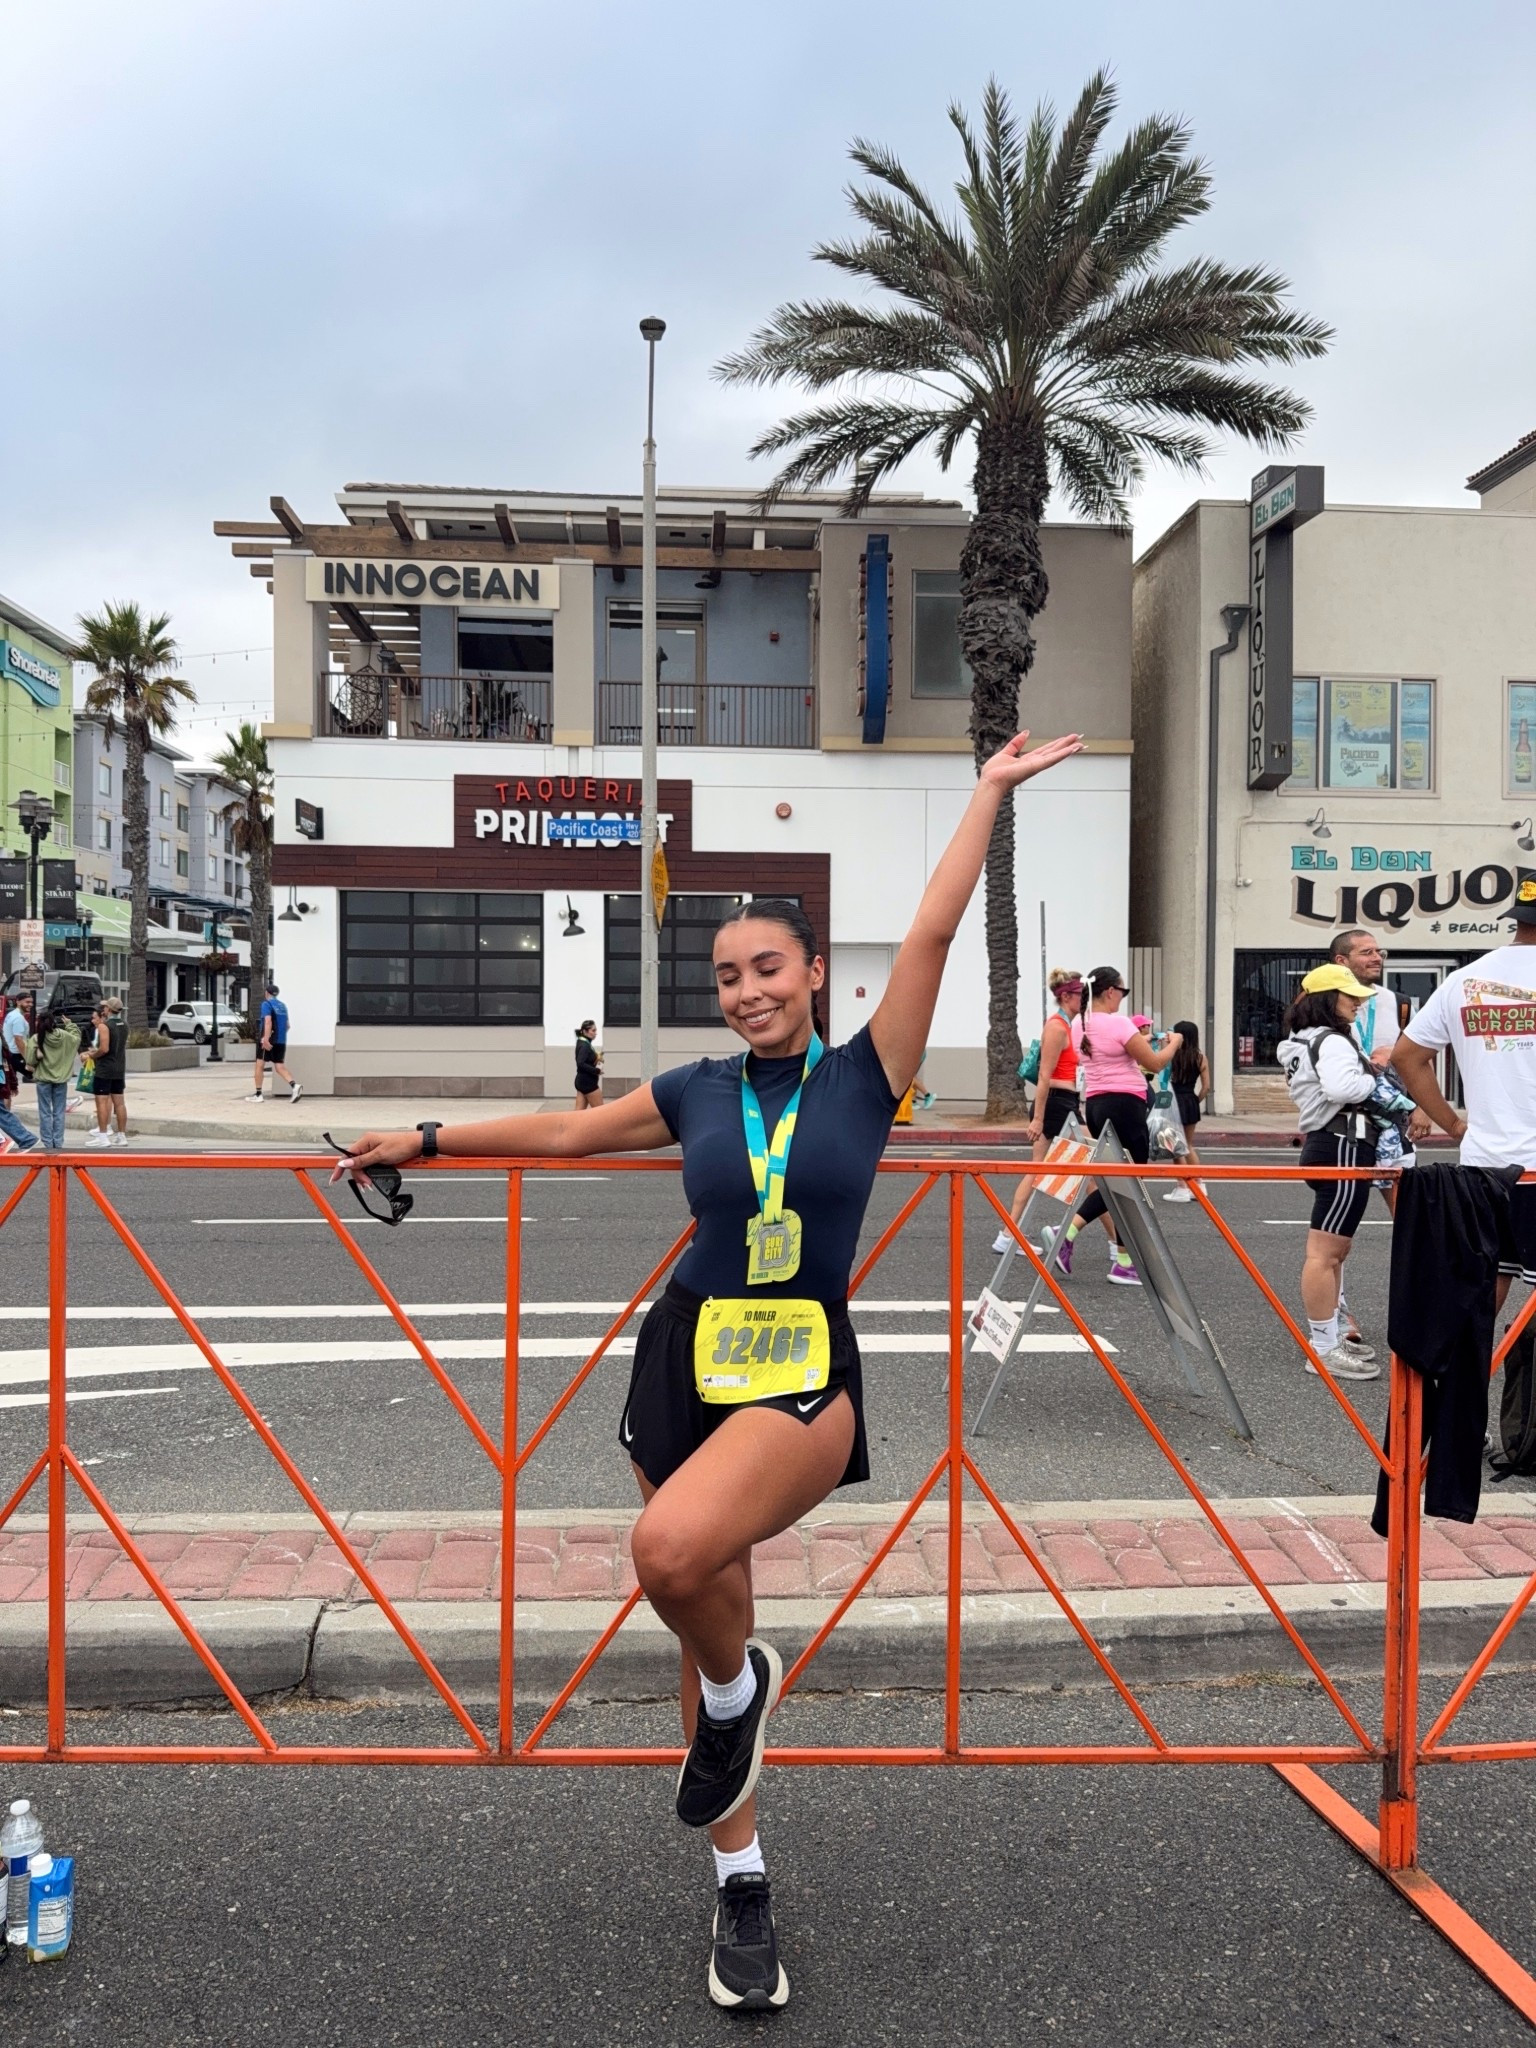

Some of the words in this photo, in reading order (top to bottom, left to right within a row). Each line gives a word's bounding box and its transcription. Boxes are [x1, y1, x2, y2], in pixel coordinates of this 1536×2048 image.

[1255, 504, 1268, 529] EL
[1271, 482, 1294, 518] DON
[324, 563, 540, 600] INNOCEAN
[1252, 548, 1265, 773] LIQUOR
[9, 647, 60, 690] Shorebreak
[495, 778, 643, 805] TAQUERI
[550, 822, 587, 836] Pacific
[590, 822, 623, 837] Coast
[625, 822, 639, 831] Hwy
[626, 830, 641, 838] 420
[1291, 846, 1338, 870] EL
[1351, 847, 1432, 871] DON
[1293, 864, 1536, 929] LIQUO
[44, 928, 84, 938] HOTE
[1448, 923, 1499, 933] BEACH
[1466, 1007, 1536, 1021] IN-N-OUT
[1468, 1020, 1535, 1032] BURGER
[765, 1236, 784, 1248] SURF
[764, 1247, 783, 1260] CITY
[744, 1311, 751, 1321] 10
[753, 1311, 777, 1321] MILER
[712, 1327, 813, 1364] 32465
